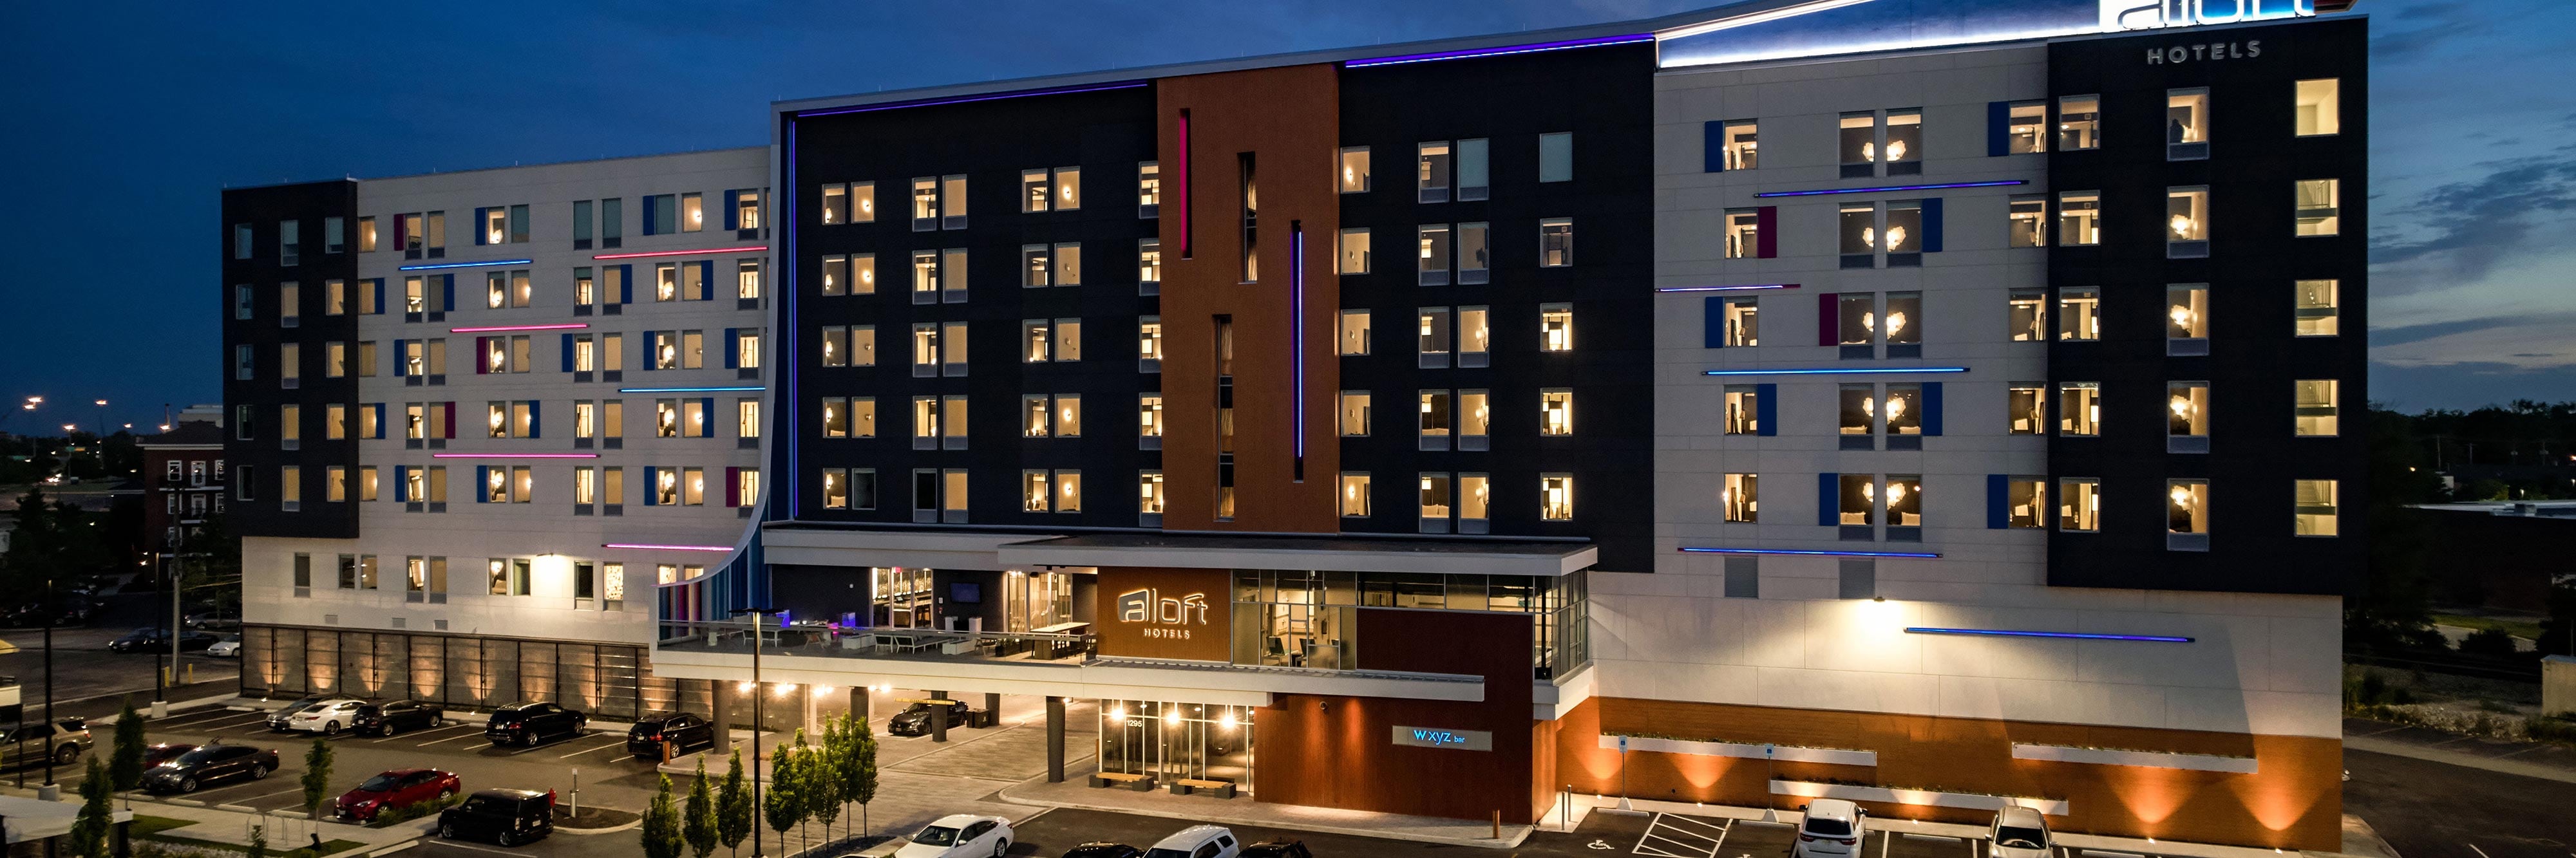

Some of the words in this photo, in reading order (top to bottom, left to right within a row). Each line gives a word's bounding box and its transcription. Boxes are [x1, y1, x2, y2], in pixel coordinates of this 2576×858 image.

[2147, 40, 2262, 65] HOTELS
[1119, 588, 1208, 625] aloft
[1144, 628, 1190, 640] HOTELS
